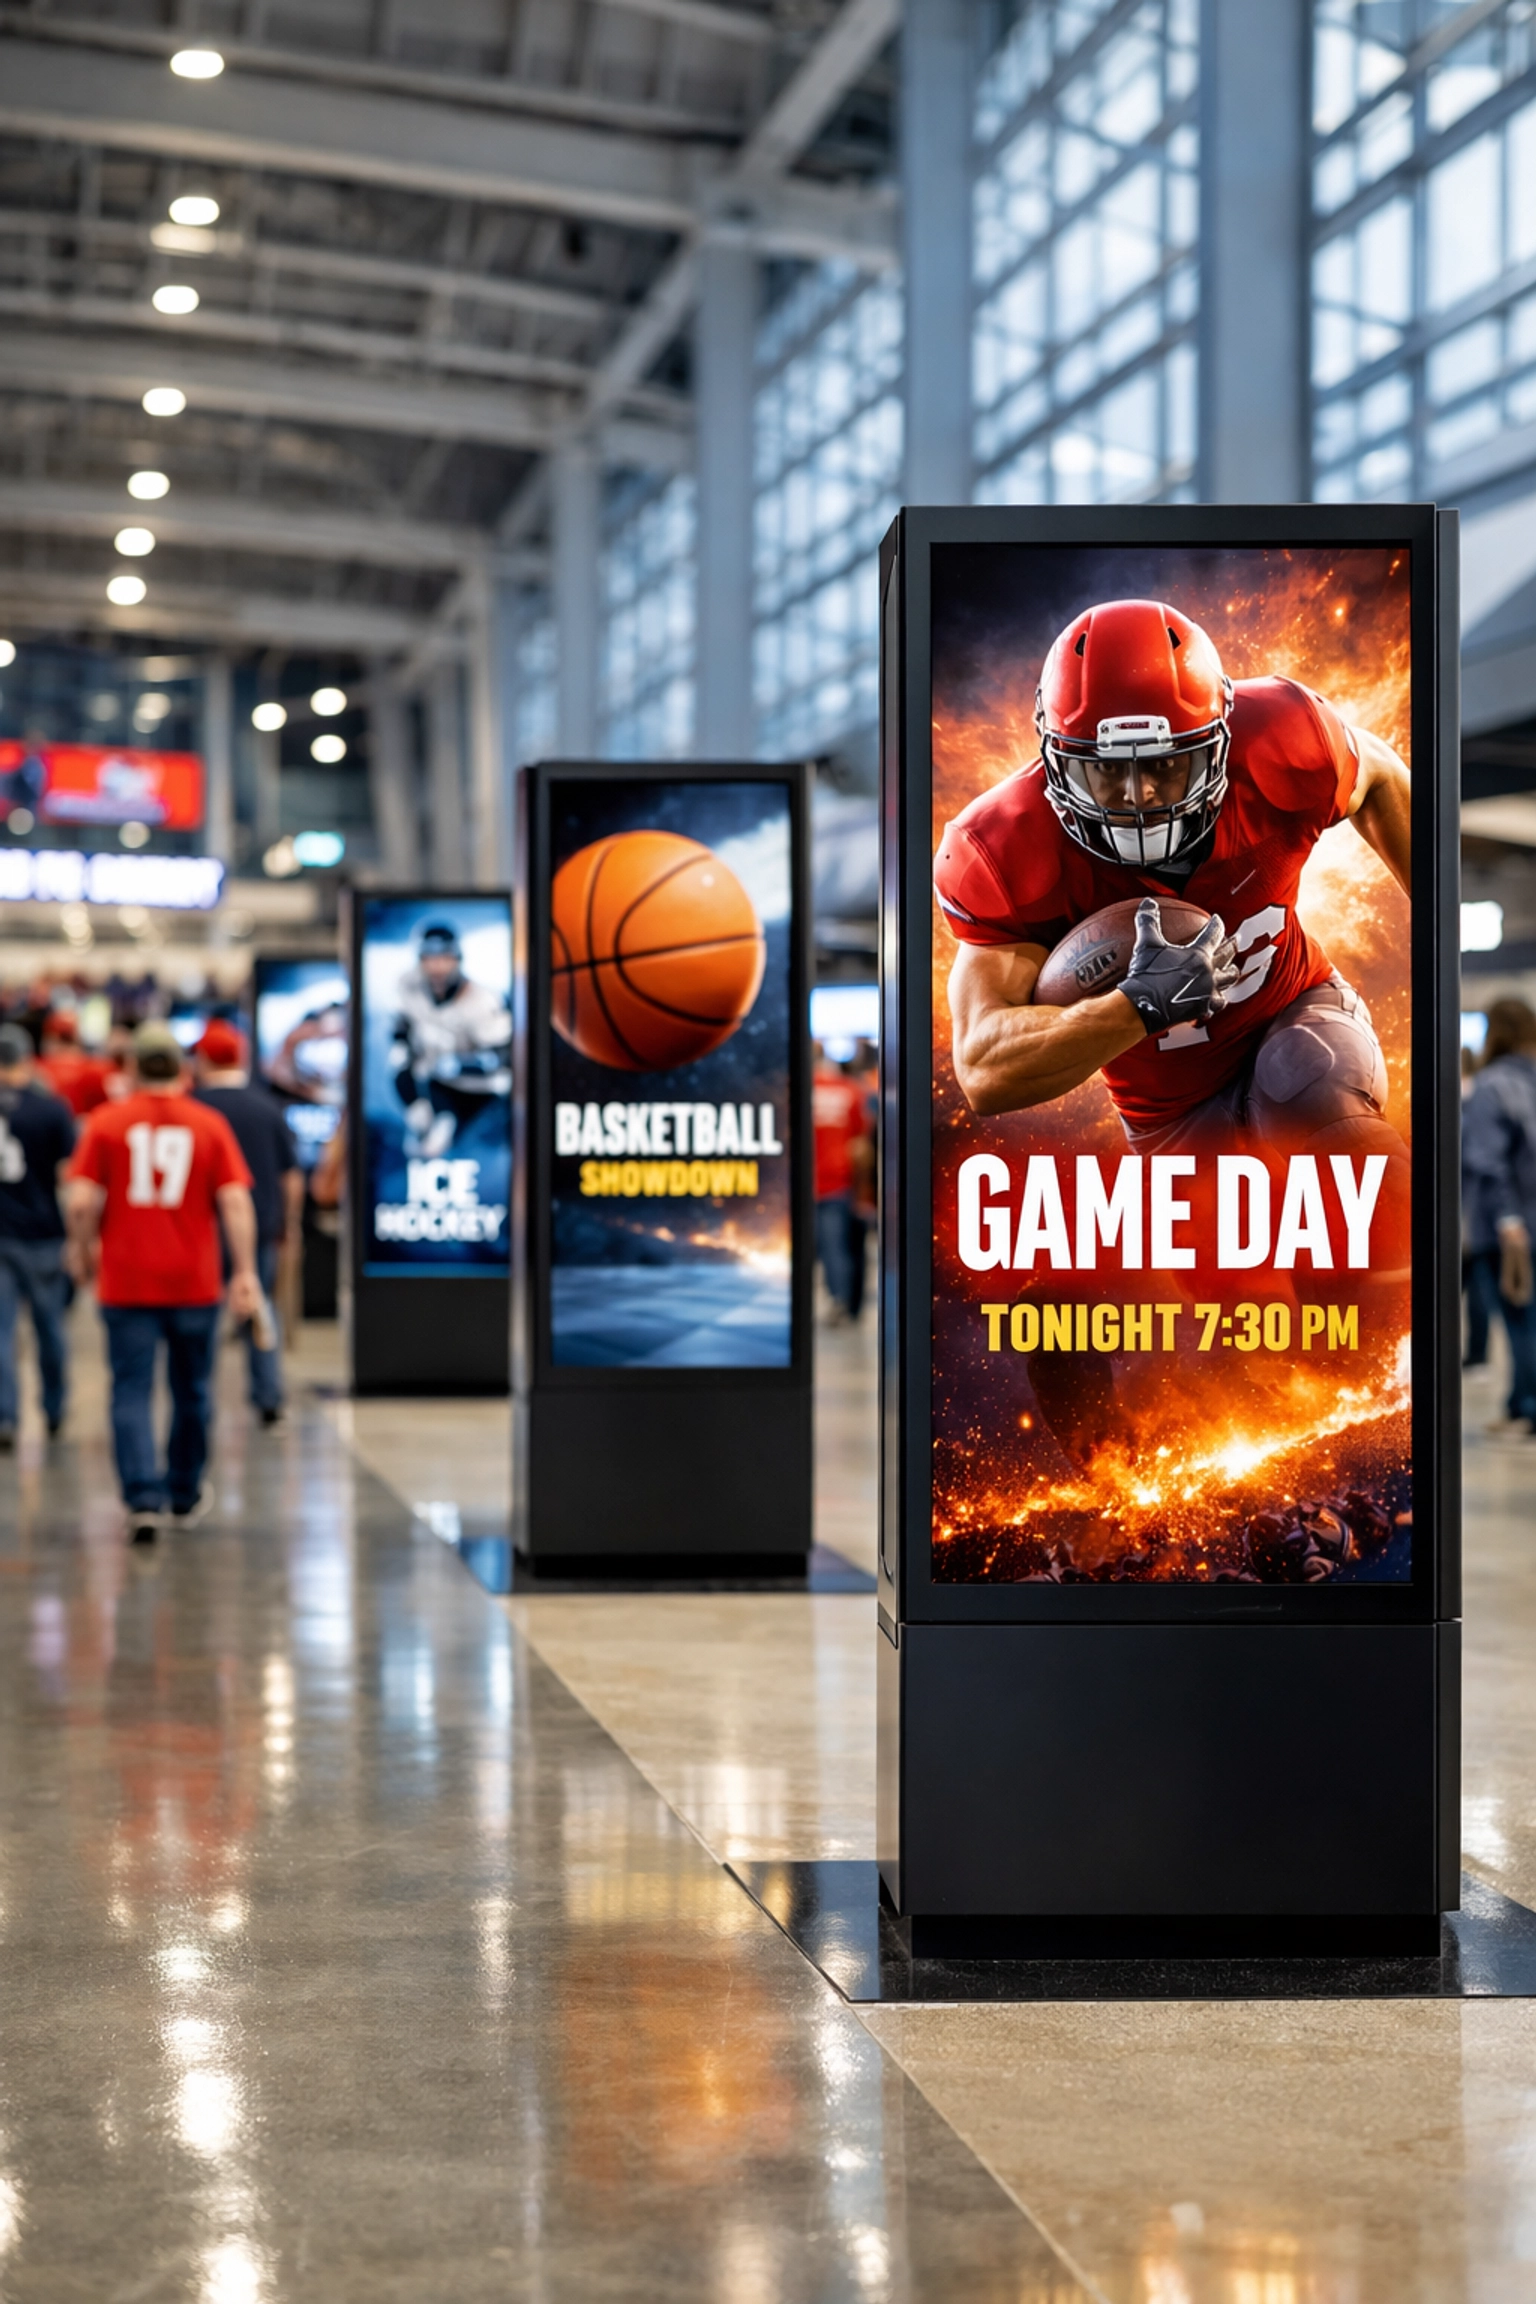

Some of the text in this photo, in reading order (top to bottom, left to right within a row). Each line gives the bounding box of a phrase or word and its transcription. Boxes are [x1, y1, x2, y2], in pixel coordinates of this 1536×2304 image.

[554, 1101, 783, 1156] BASKETBALL
[124, 1121, 195, 1209] 19
[406, 1158, 481, 1208] ICE
[578, 1160, 759, 1197] SHOWDOWN
[374, 1202, 507, 1242] HOCKEY
[957, 1153, 1389, 1271] GAME DAY
[981, 1302, 1359, 1353] TONIGHT 7:30 PM
